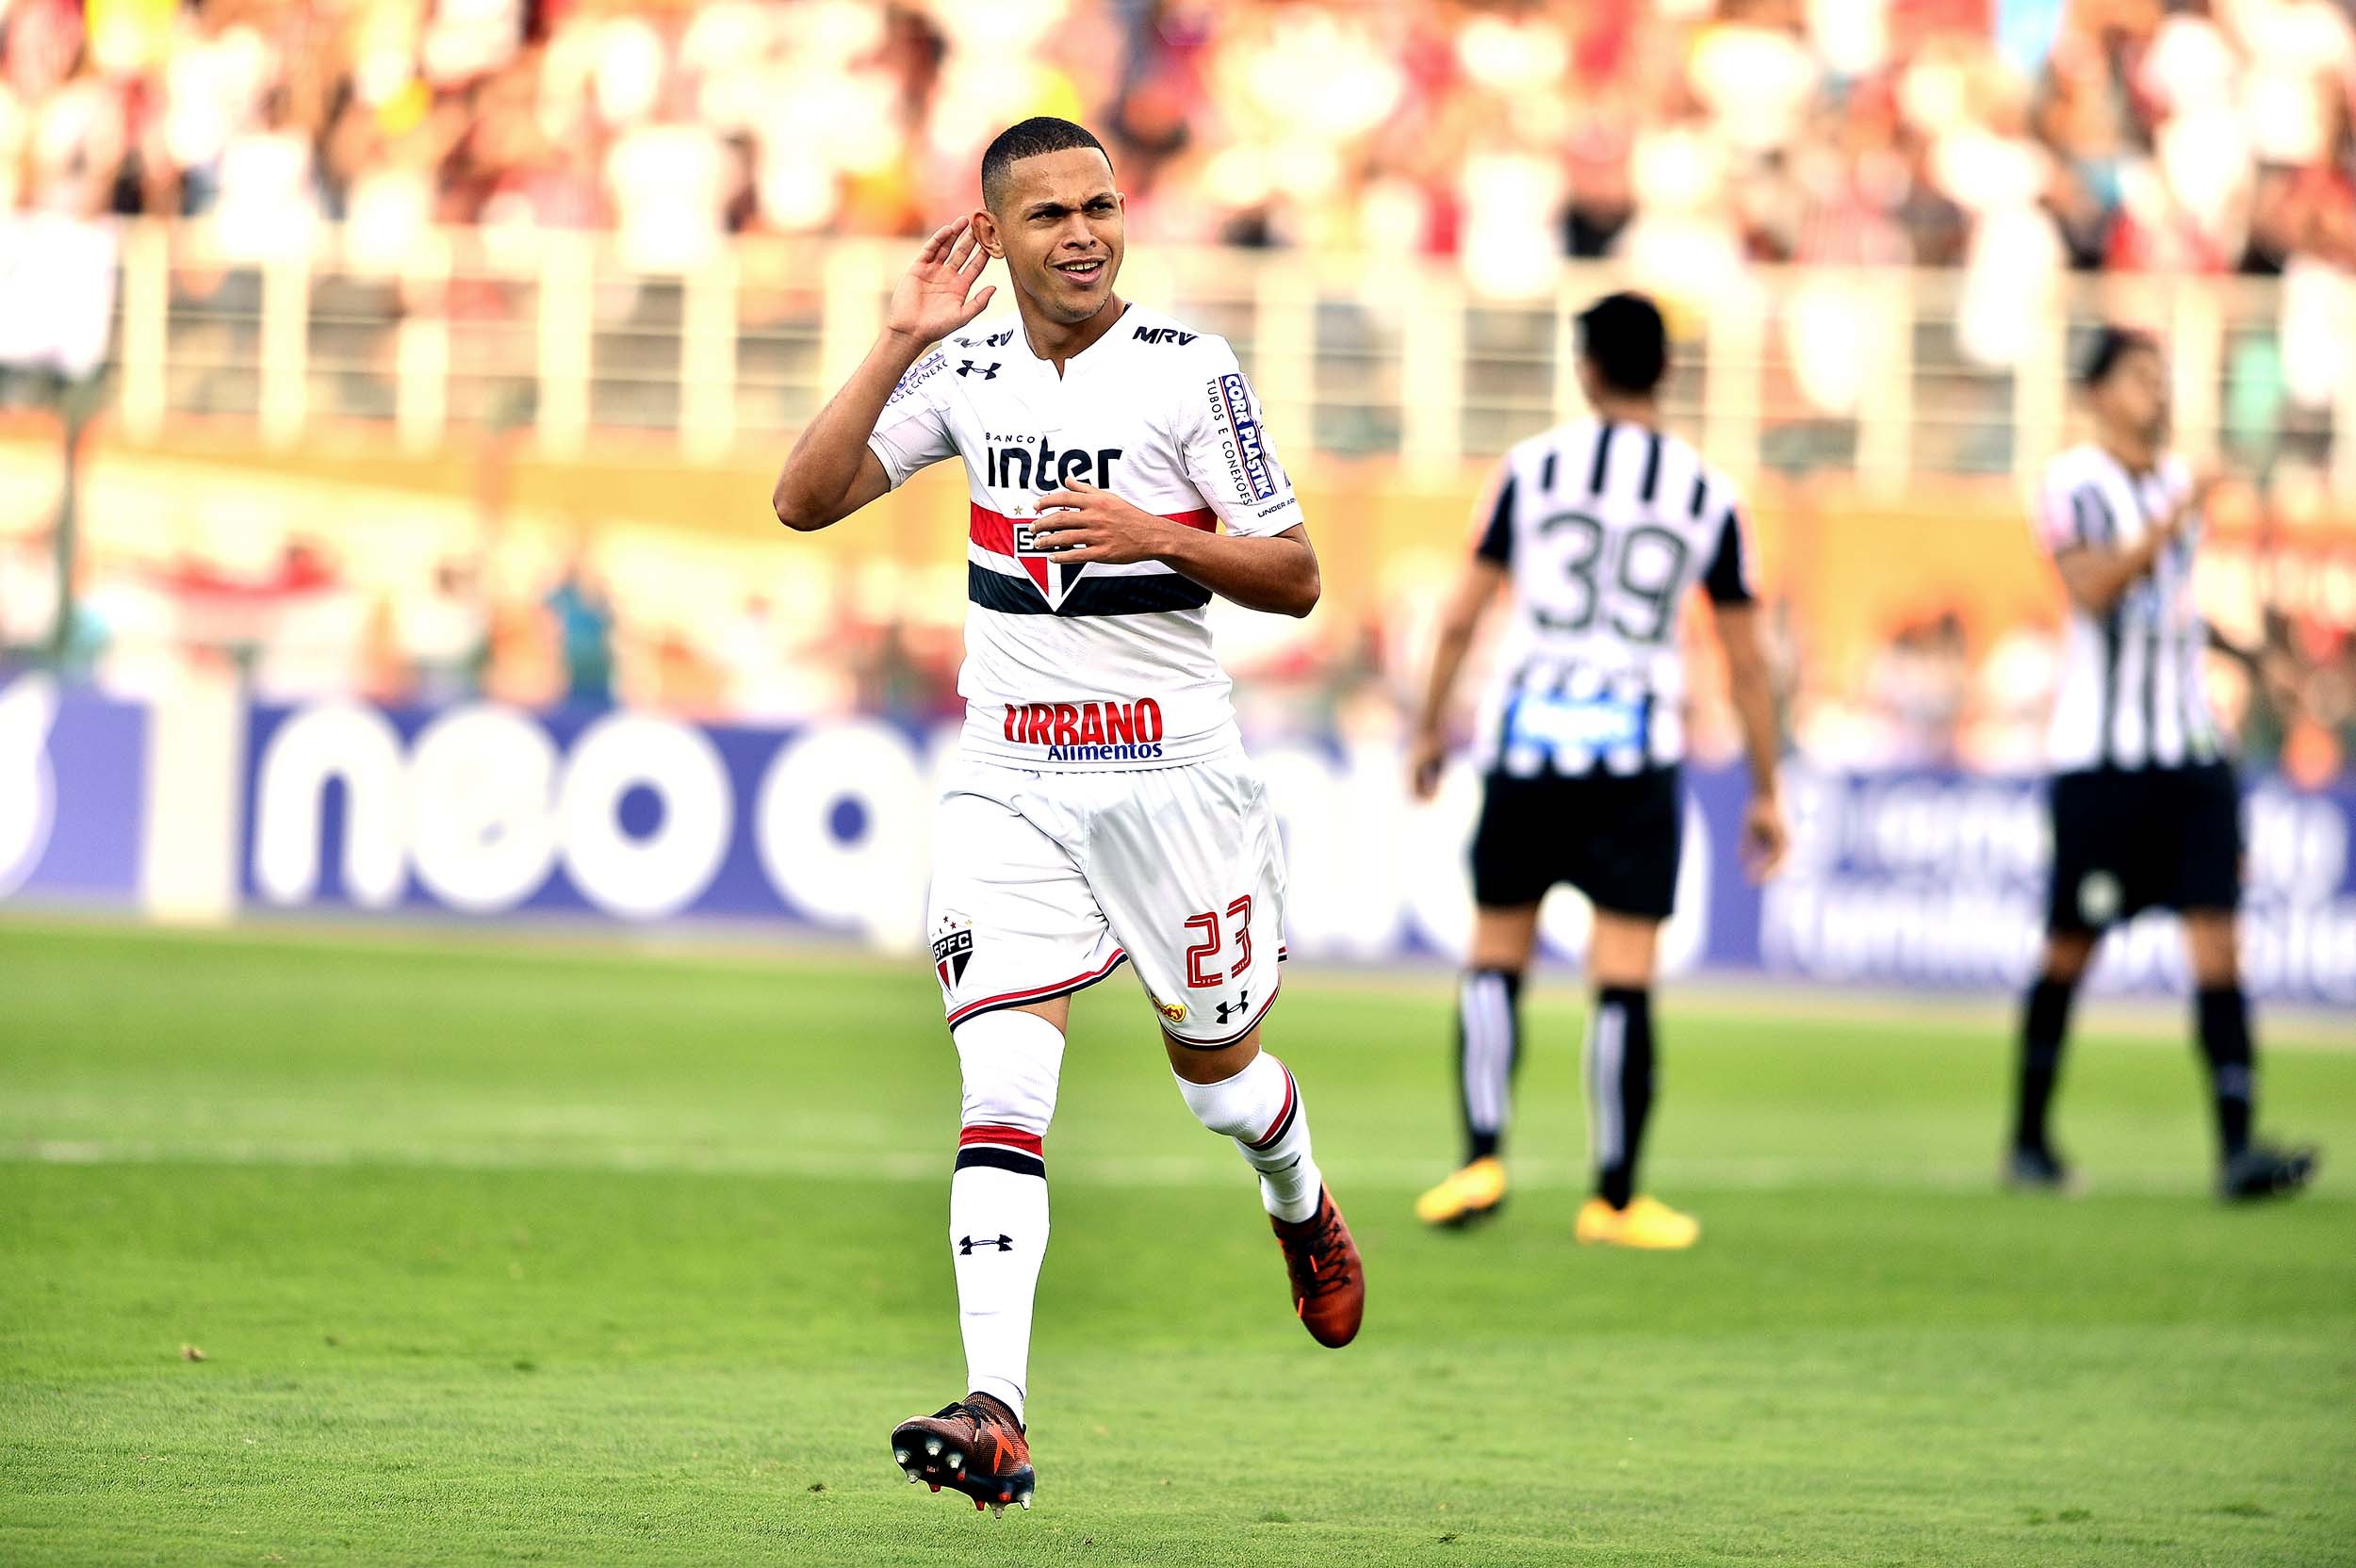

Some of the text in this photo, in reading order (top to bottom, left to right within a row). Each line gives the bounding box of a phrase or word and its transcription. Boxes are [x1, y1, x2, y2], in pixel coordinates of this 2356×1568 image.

[1132, 326, 1199, 346] MRV
[985, 432, 1036, 444] BANCO
[1206, 379, 1224, 421] TUBOS
[1222, 440, 1253, 506] CONEXÕES
[1223, 375, 1274, 498] CORR PLASTIK
[988, 435, 1123, 492] inter
[1257, 501, 1286, 518] UNDER
[1530, 511, 1690, 645] 39
[1004, 697, 1164, 746] URBANO
[1047, 742, 1164, 761] Alimentos
[256, 699, 737, 918] neo
[933, 933, 971, 960] SPFC
[1184, 894, 1252, 988] 23
